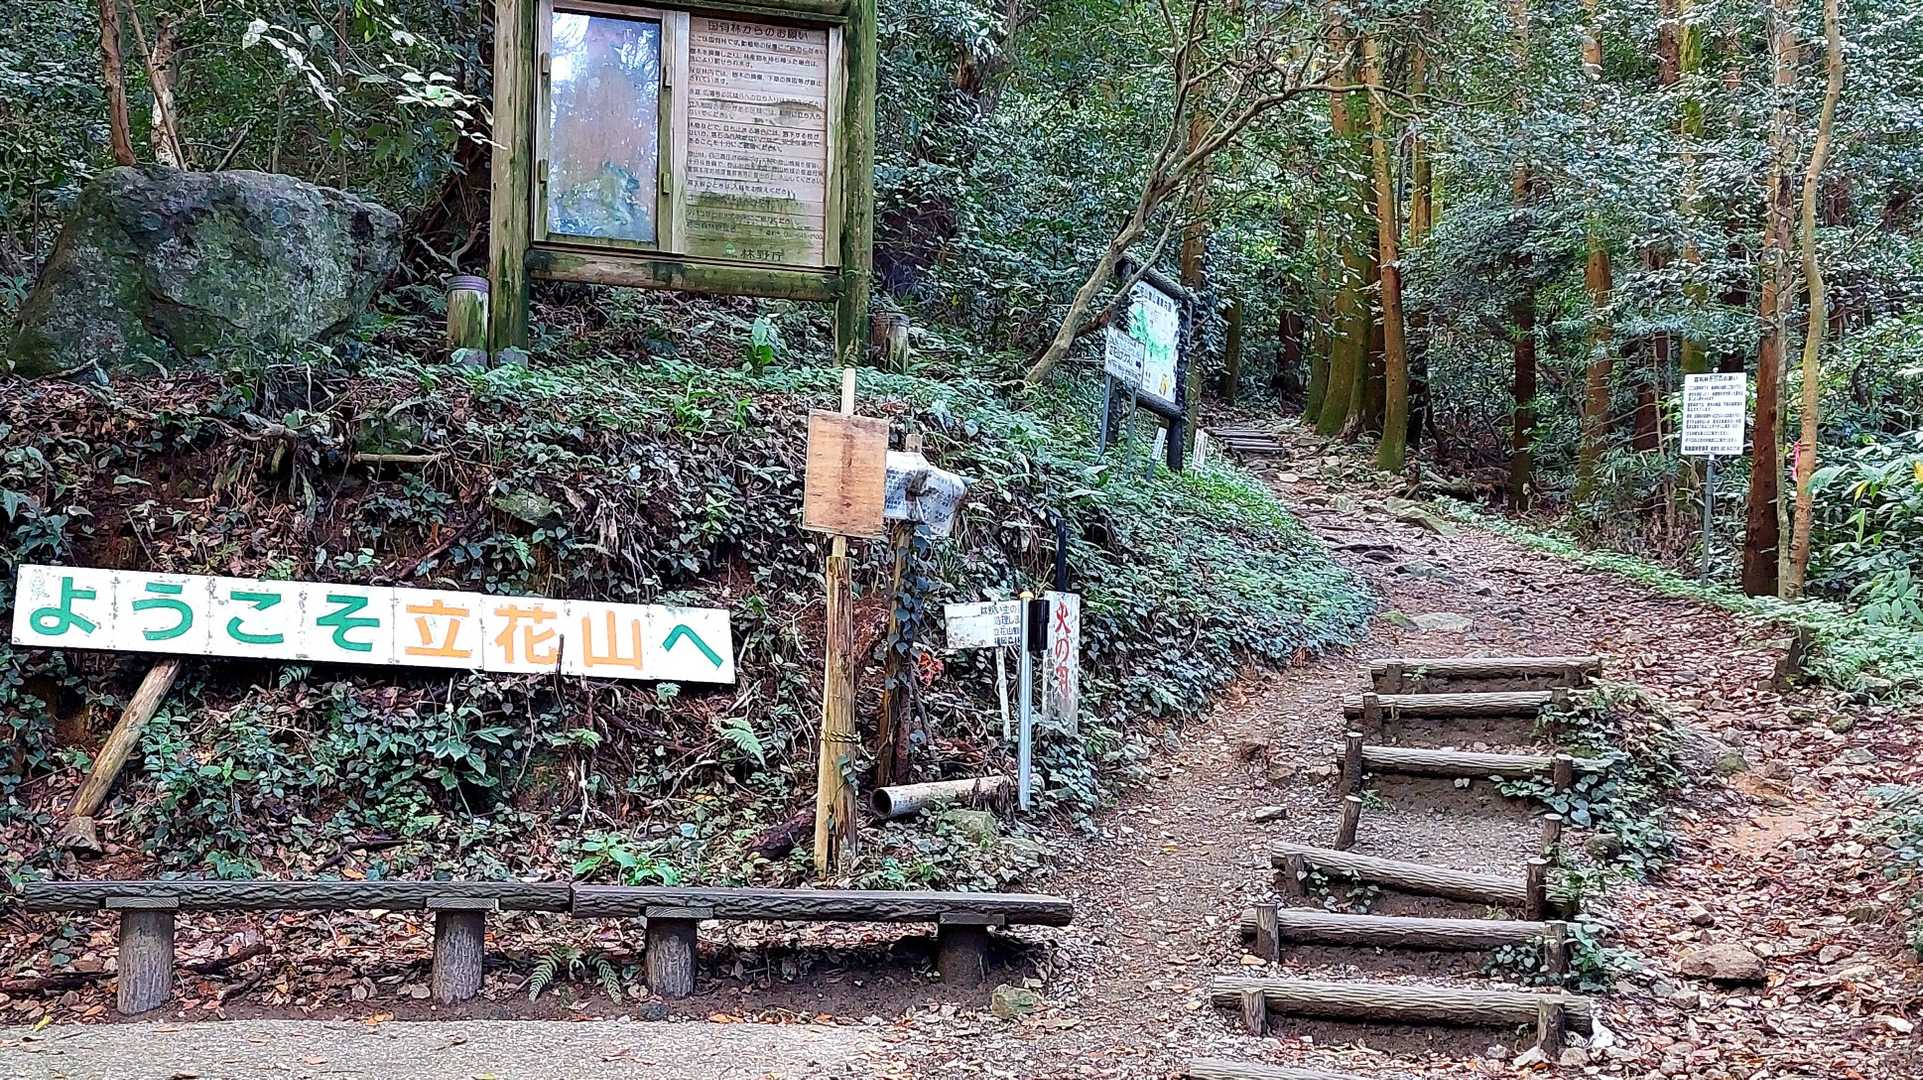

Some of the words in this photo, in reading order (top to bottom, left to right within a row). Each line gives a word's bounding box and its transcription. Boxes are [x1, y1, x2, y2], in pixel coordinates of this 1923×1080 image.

[707, 20, 809, 41] 国有林からのお願い
[739, 247, 784, 262] 林野庁
[29, 576, 725, 670] ようこそ立花山へ
